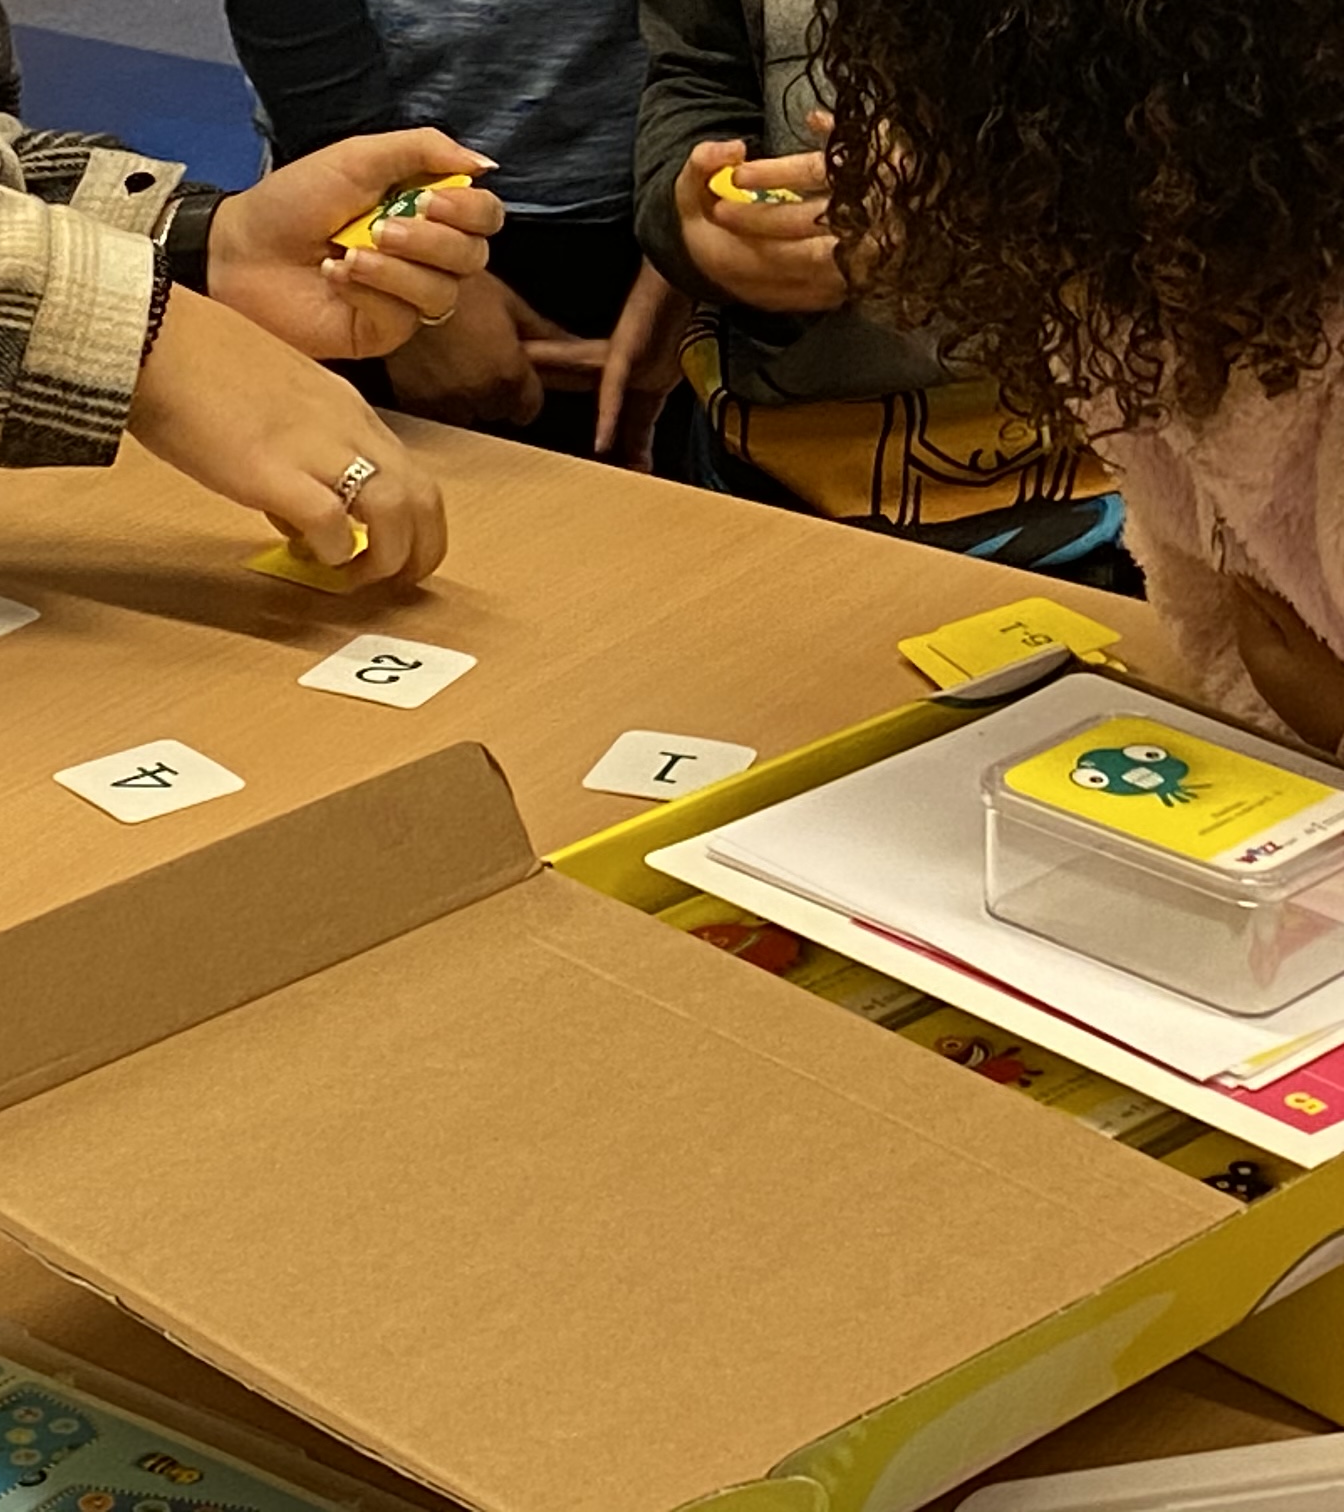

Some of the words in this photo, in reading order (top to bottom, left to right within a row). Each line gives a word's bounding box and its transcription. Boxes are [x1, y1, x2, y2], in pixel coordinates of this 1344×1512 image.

[355, 654, 423, 684] 2
[110, 761, 179, 788] 4
[653, 751, 698, 784] 1
